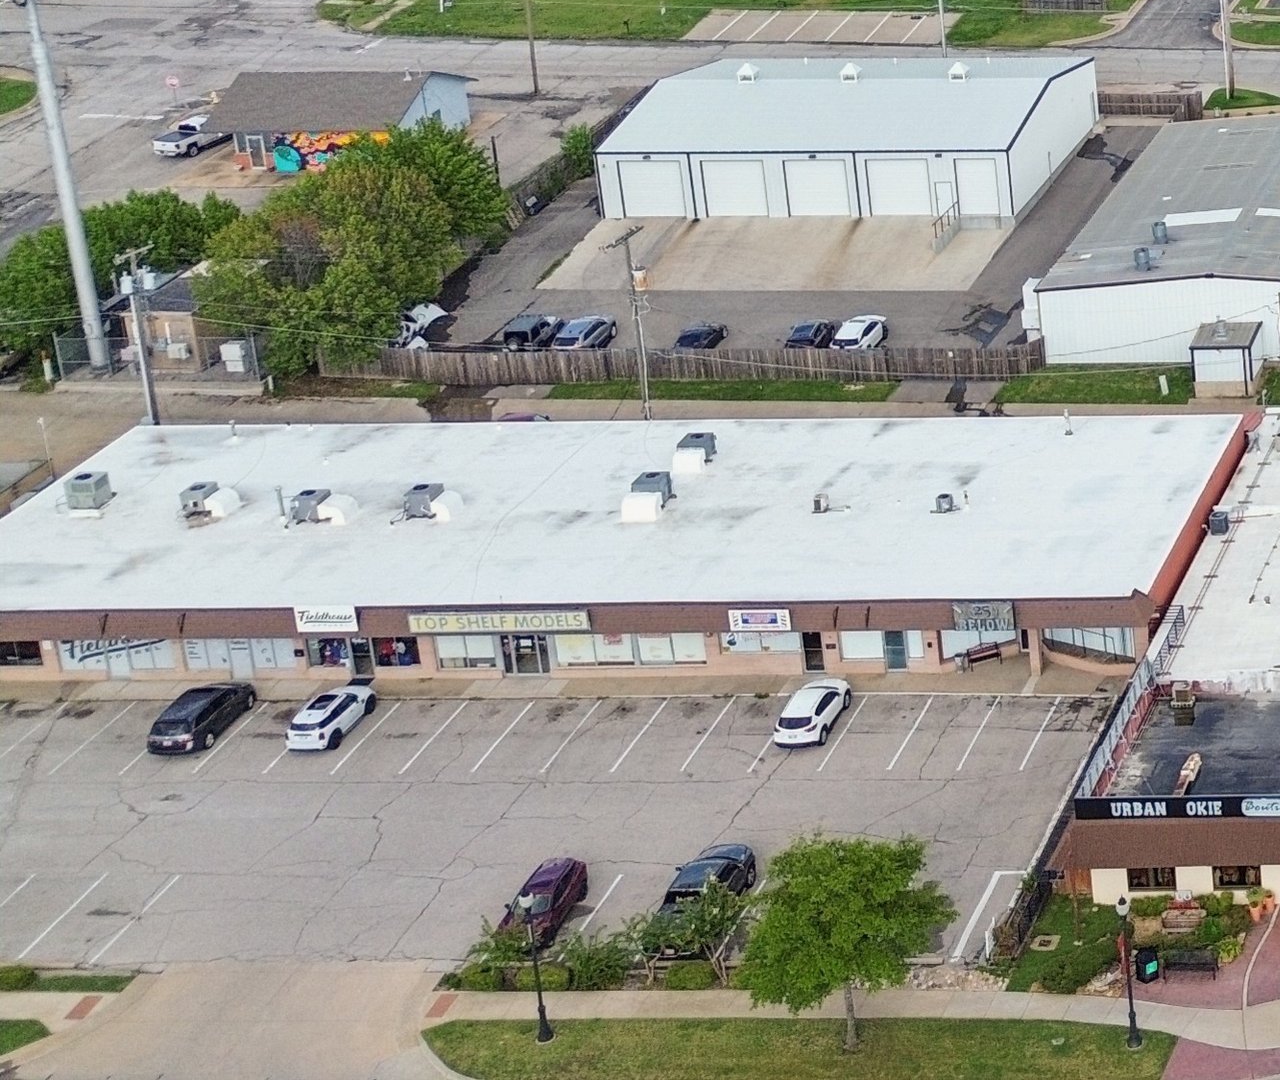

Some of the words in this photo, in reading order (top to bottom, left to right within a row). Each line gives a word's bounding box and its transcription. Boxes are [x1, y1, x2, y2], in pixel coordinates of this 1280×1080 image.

[298, 610, 352, 622] Fieldhouse
[973, 605, 992, 618] 25
[414, 617, 448, 630] TOP
[457, 616, 508, 629] SHELF
[514, 614, 583, 628] MODELS
[960, 619, 1009, 631] BELOW
[1110, 801, 1167, 817] URBAN
[1186, 801, 1223, 816] OKIE
